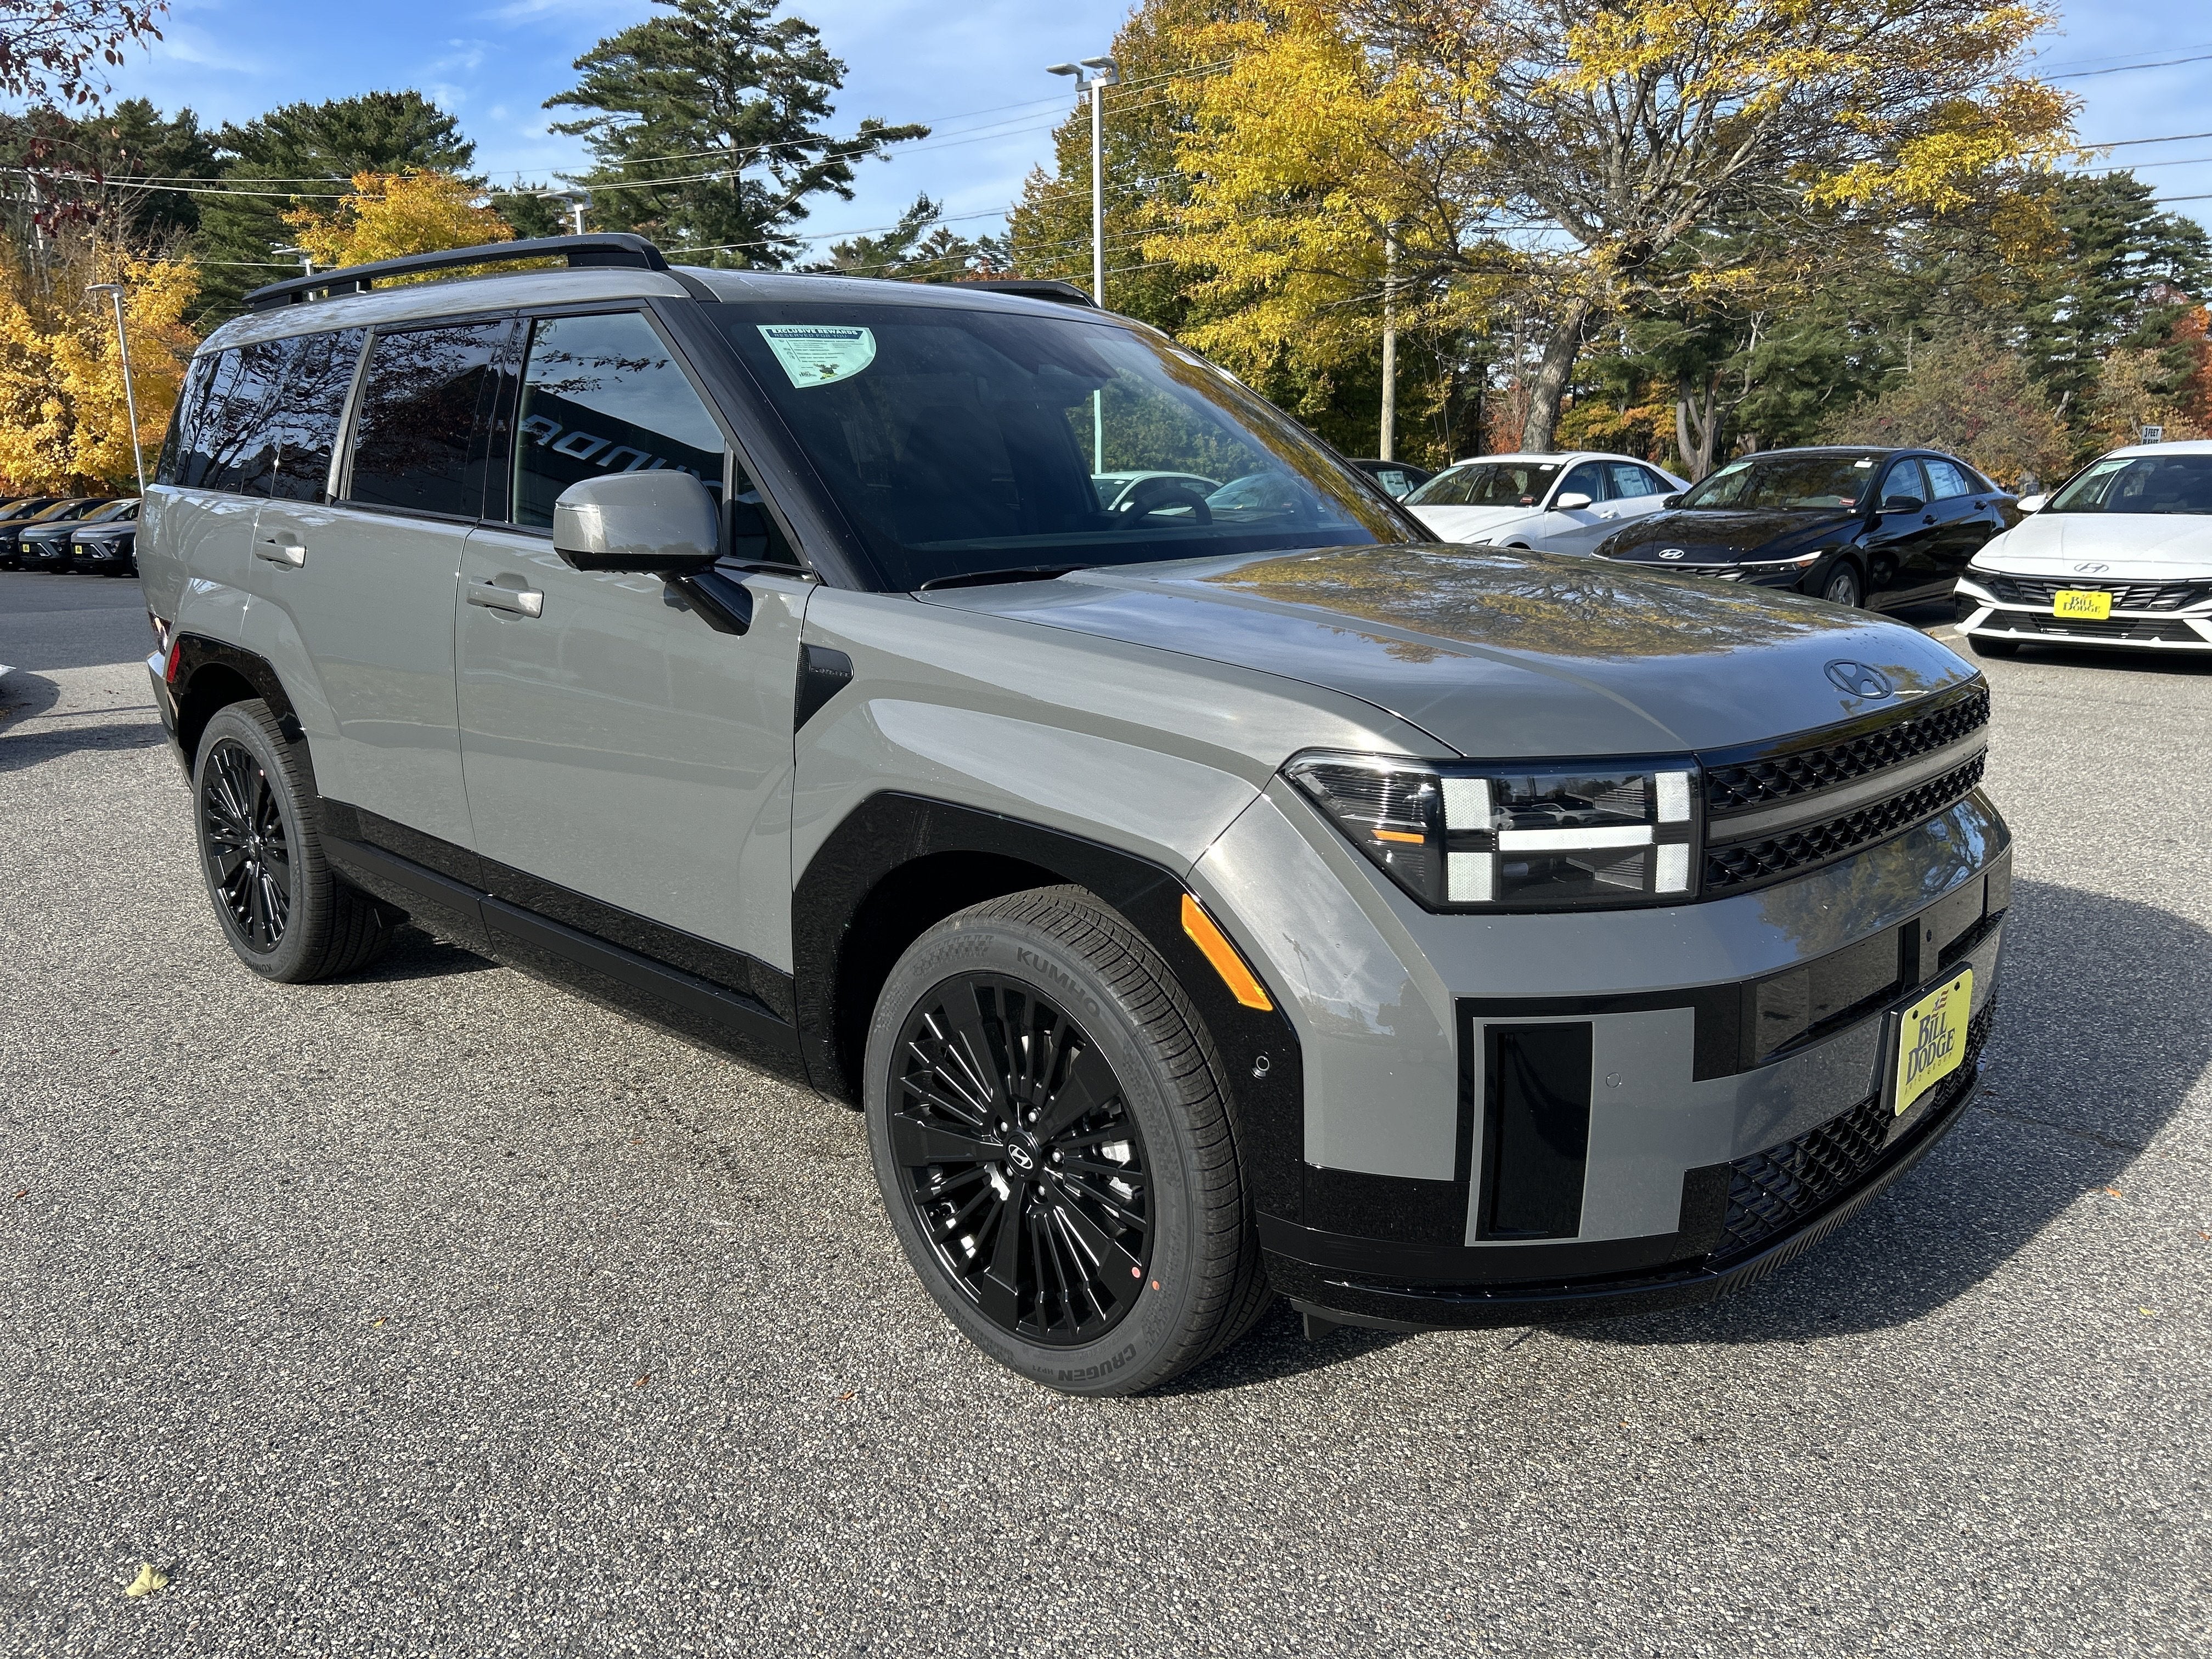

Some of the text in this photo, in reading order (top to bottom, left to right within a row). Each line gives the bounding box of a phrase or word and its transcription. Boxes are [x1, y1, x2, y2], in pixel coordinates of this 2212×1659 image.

[2144, 427, 2159, 437] 3 FEET
[2063, 602, 2100, 613] DODGE
[2071, 596, 2094, 607] BILL
[245, 957, 273, 973] KUMHO
[1017, 947, 1100, 1018] KUMHO
[1918, 1012, 1948, 1049] BILL
[1906, 1028, 1955, 1085] DODGE
[1032, 1364, 1054, 1375] HP71
[1058, 1343, 1137, 1382] CRUGEN
